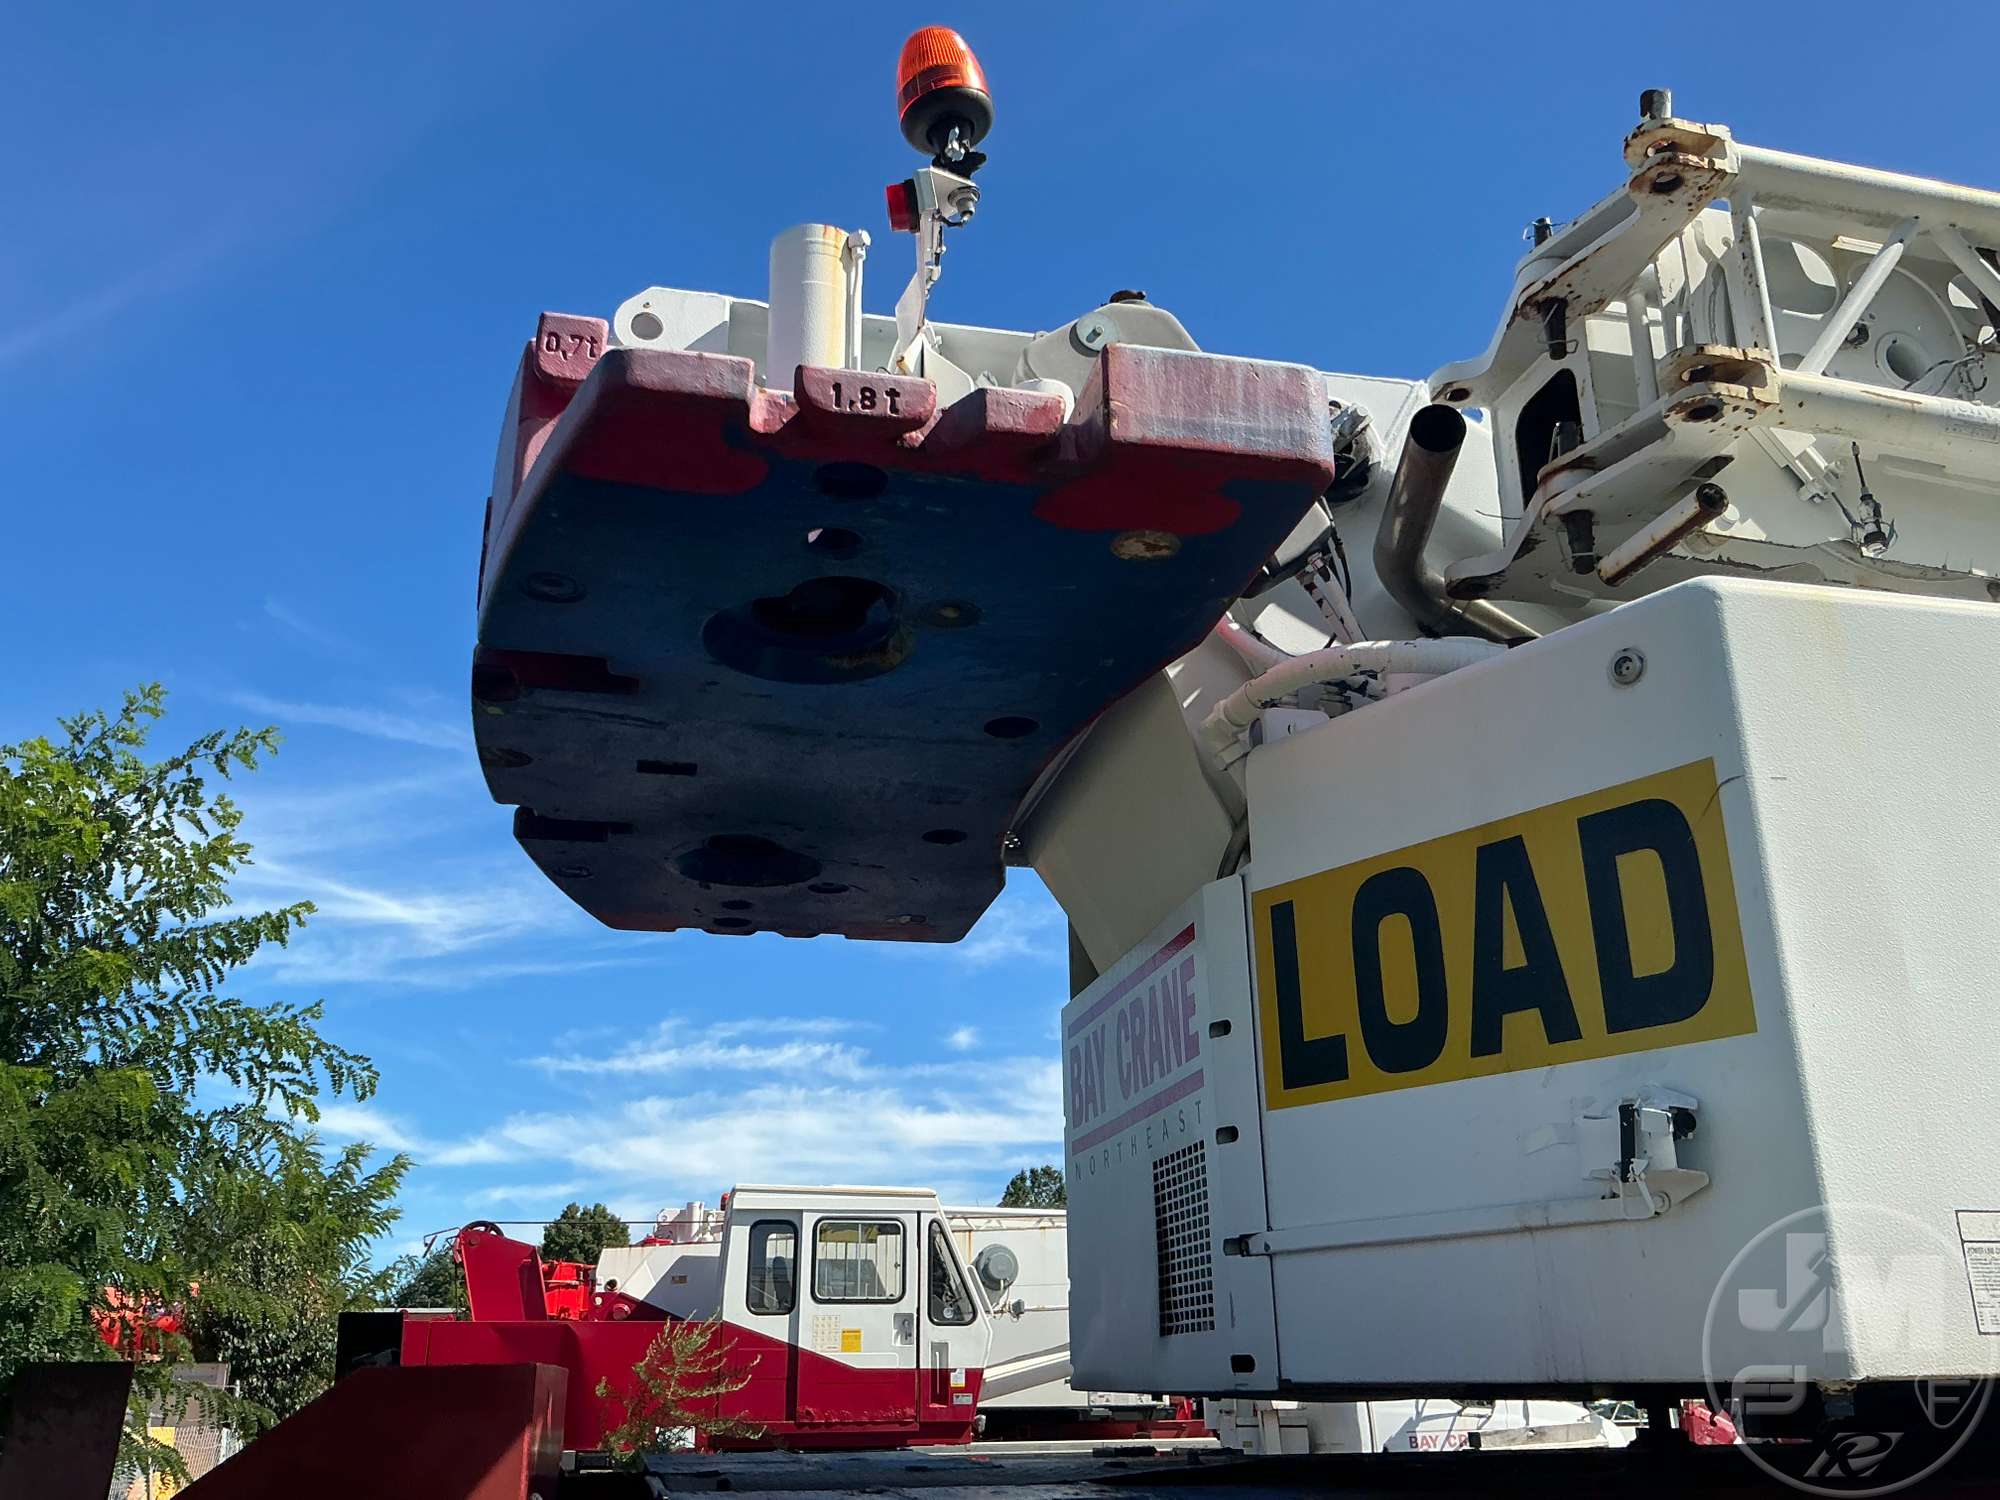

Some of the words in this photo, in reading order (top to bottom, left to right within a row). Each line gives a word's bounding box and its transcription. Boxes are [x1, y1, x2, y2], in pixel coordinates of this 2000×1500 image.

[1270, 798, 1714, 1090] LOAD
[1070, 1024, 1107, 1130] BAY
[1116, 955, 1200, 1101] CRANE
[1074, 1100, 1202, 1182] NORTHEAST
[1408, 1435, 1440, 1449] BAY
